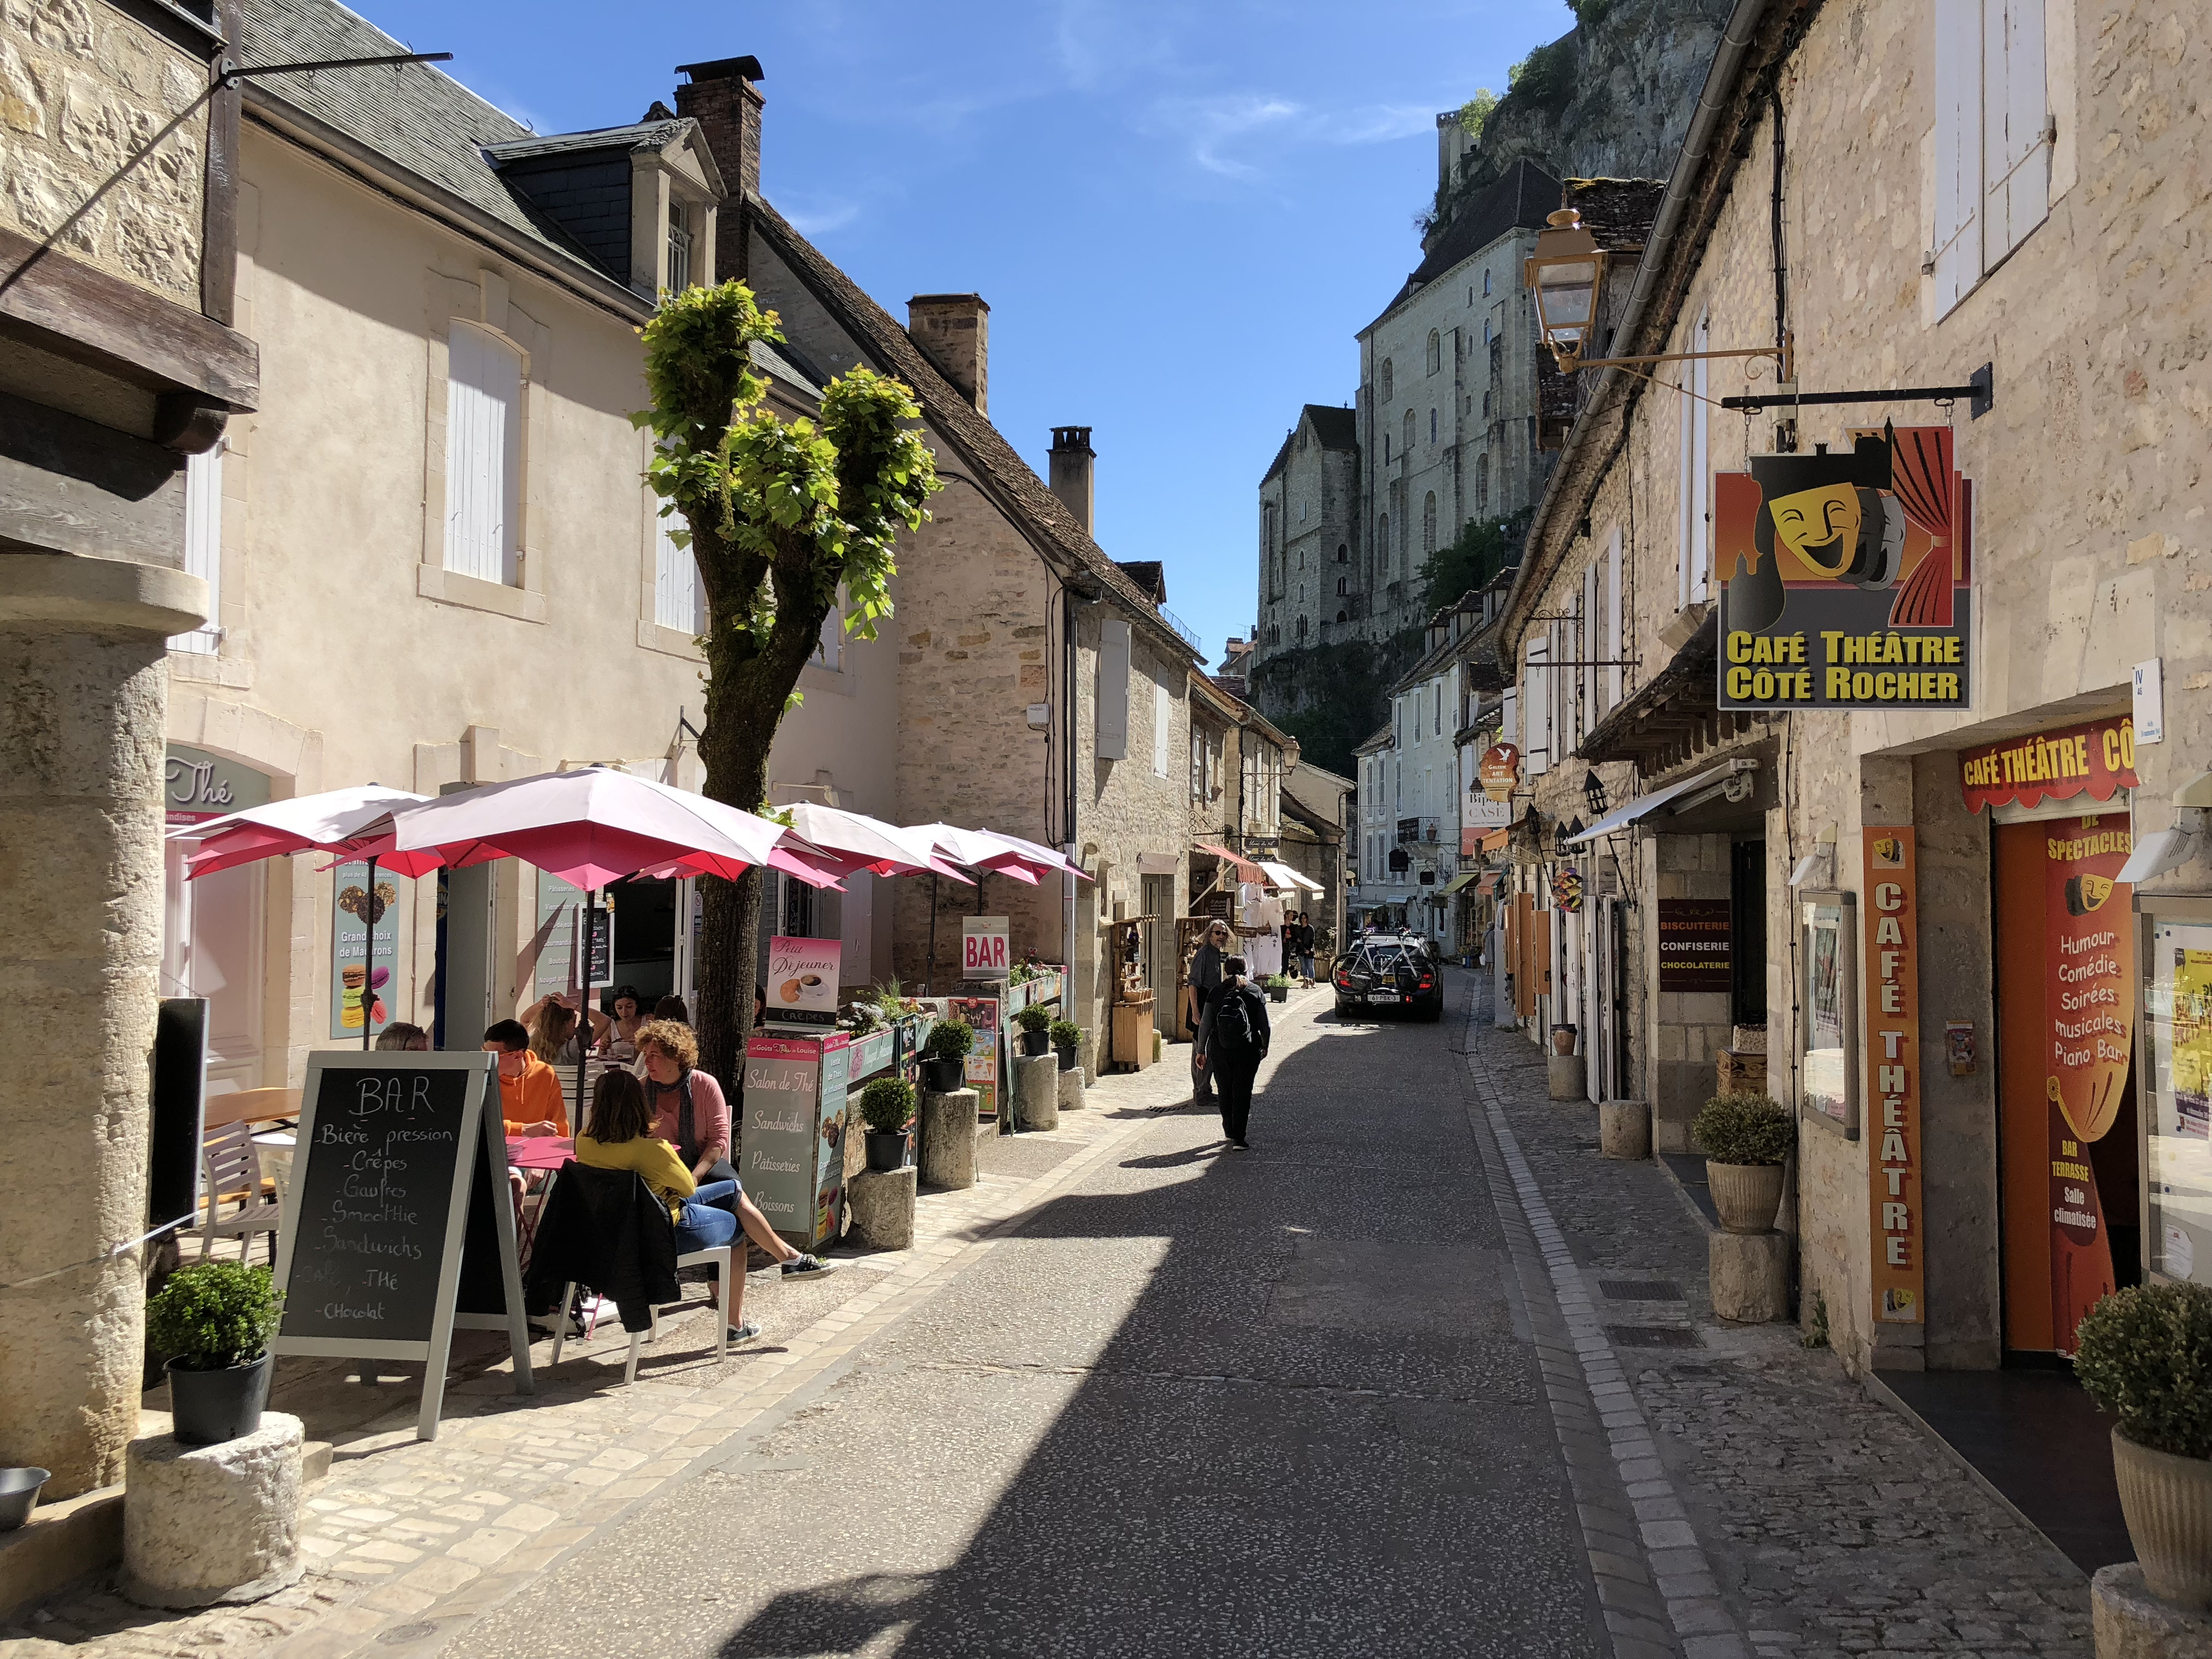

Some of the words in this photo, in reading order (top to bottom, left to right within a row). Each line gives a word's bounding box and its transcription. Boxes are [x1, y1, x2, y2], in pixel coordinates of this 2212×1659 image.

[1727, 630, 1805, 664] CAFÉ
[1820, 630, 1960, 664] THÉÂTRE
[1727, 666, 1811, 699] CÔTÉ
[1827, 666, 1958, 699] ROCHER
[2136, 669, 2143, 685] IV
[1964, 748, 2000, 785] CAFÉ
[2001, 735, 2089, 783] THÉÂTRE
[166, 755, 233, 804] Thé
[1469, 807, 1504, 817] CASE
[2048, 832, 2132, 861] SPECTACLES
[341, 932, 367, 942] Grand
[372, 931, 392, 941] hoix
[1661, 922, 1729, 930] BISCUITERIE
[340, 947, 350, 957] de
[353, 946, 393, 957] Marons
[774, 938, 804, 954] Petit
[966, 936, 1006, 968] BAR
[1661, 942, 1729, 951] CONFISERIE
[1875, 881, 1902, 1013] CAFÉ
[2060, 931, 2115, 955] Humour
[2058, 954, 2117, 983] Comédie
[2061, 983, 2115, 1010] Soirées
[2055, 1010, 2122, 1039] musicales
[2055, 1041, 2090, 1066] Piano
[2098, 1039, 2123, 1062] Bar
[747, 1068, 776, 1090] Salon
[779, 1070, 791, 1091] de
[792, 1071, 815, 1093] Thé
[348, 1076, 435, 1116] BAR
[752, 1109, 804, 1133] Sandwichs
[386, 1128, 453, 1155] pression
[1878, 1030, 1909, 1265] THÉÂTRE
[2062, 1140, 2078, 1157] BAR
[352, 1148, 408, 1181] Crêpes
[751, 1149, 801, 1173] Pâtisseries
[2052, 1161, 2089, 1182] TERRASSE
[344, 1174, 406, 1207] Gaufres
[754, 1190, 795, 1213] Boissons
[2064, 1186, 2085, 1206] Salle
[2054, 1207, 2096, 1229] climatisée
